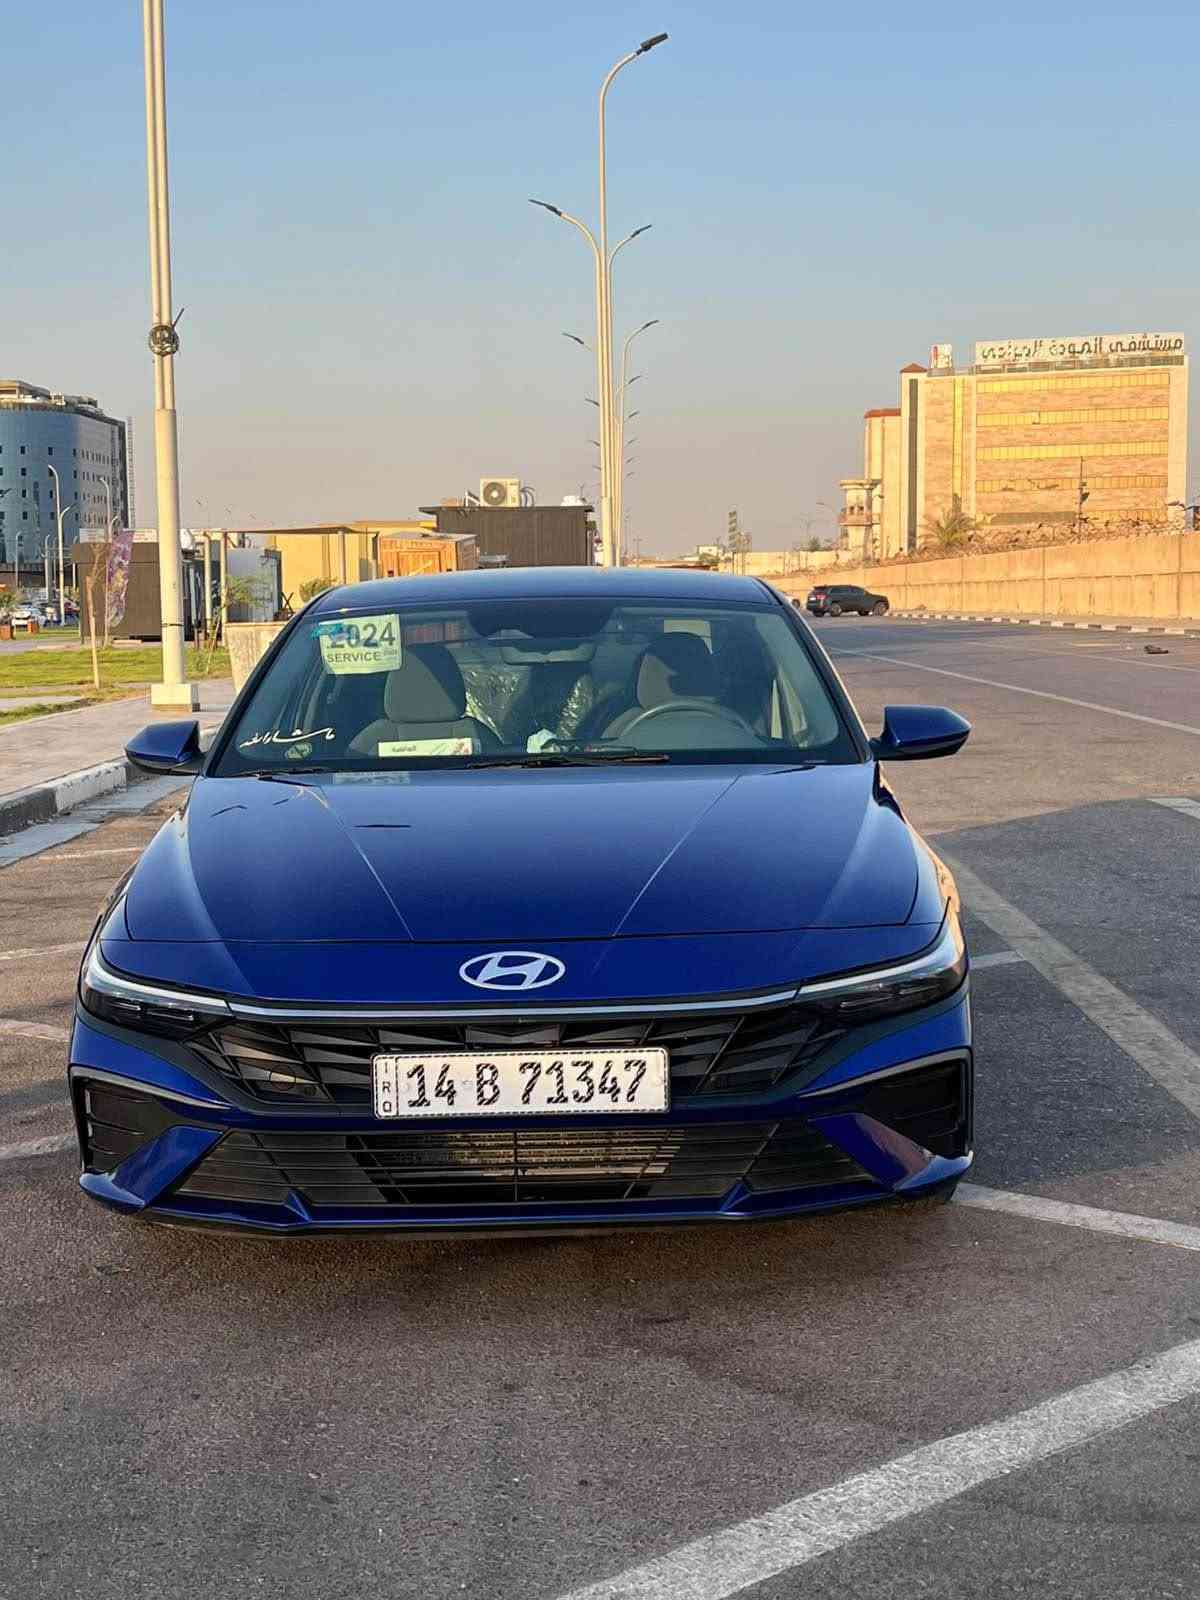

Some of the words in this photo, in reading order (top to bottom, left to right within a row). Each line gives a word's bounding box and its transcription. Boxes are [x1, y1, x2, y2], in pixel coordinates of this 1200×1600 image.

[326, 652, 382, 663] SERVICE
[407, 1063, 457, 1107] 14
[476, 1063, 499, 1105] B
[519, 1060, 646, 1104] 71347
